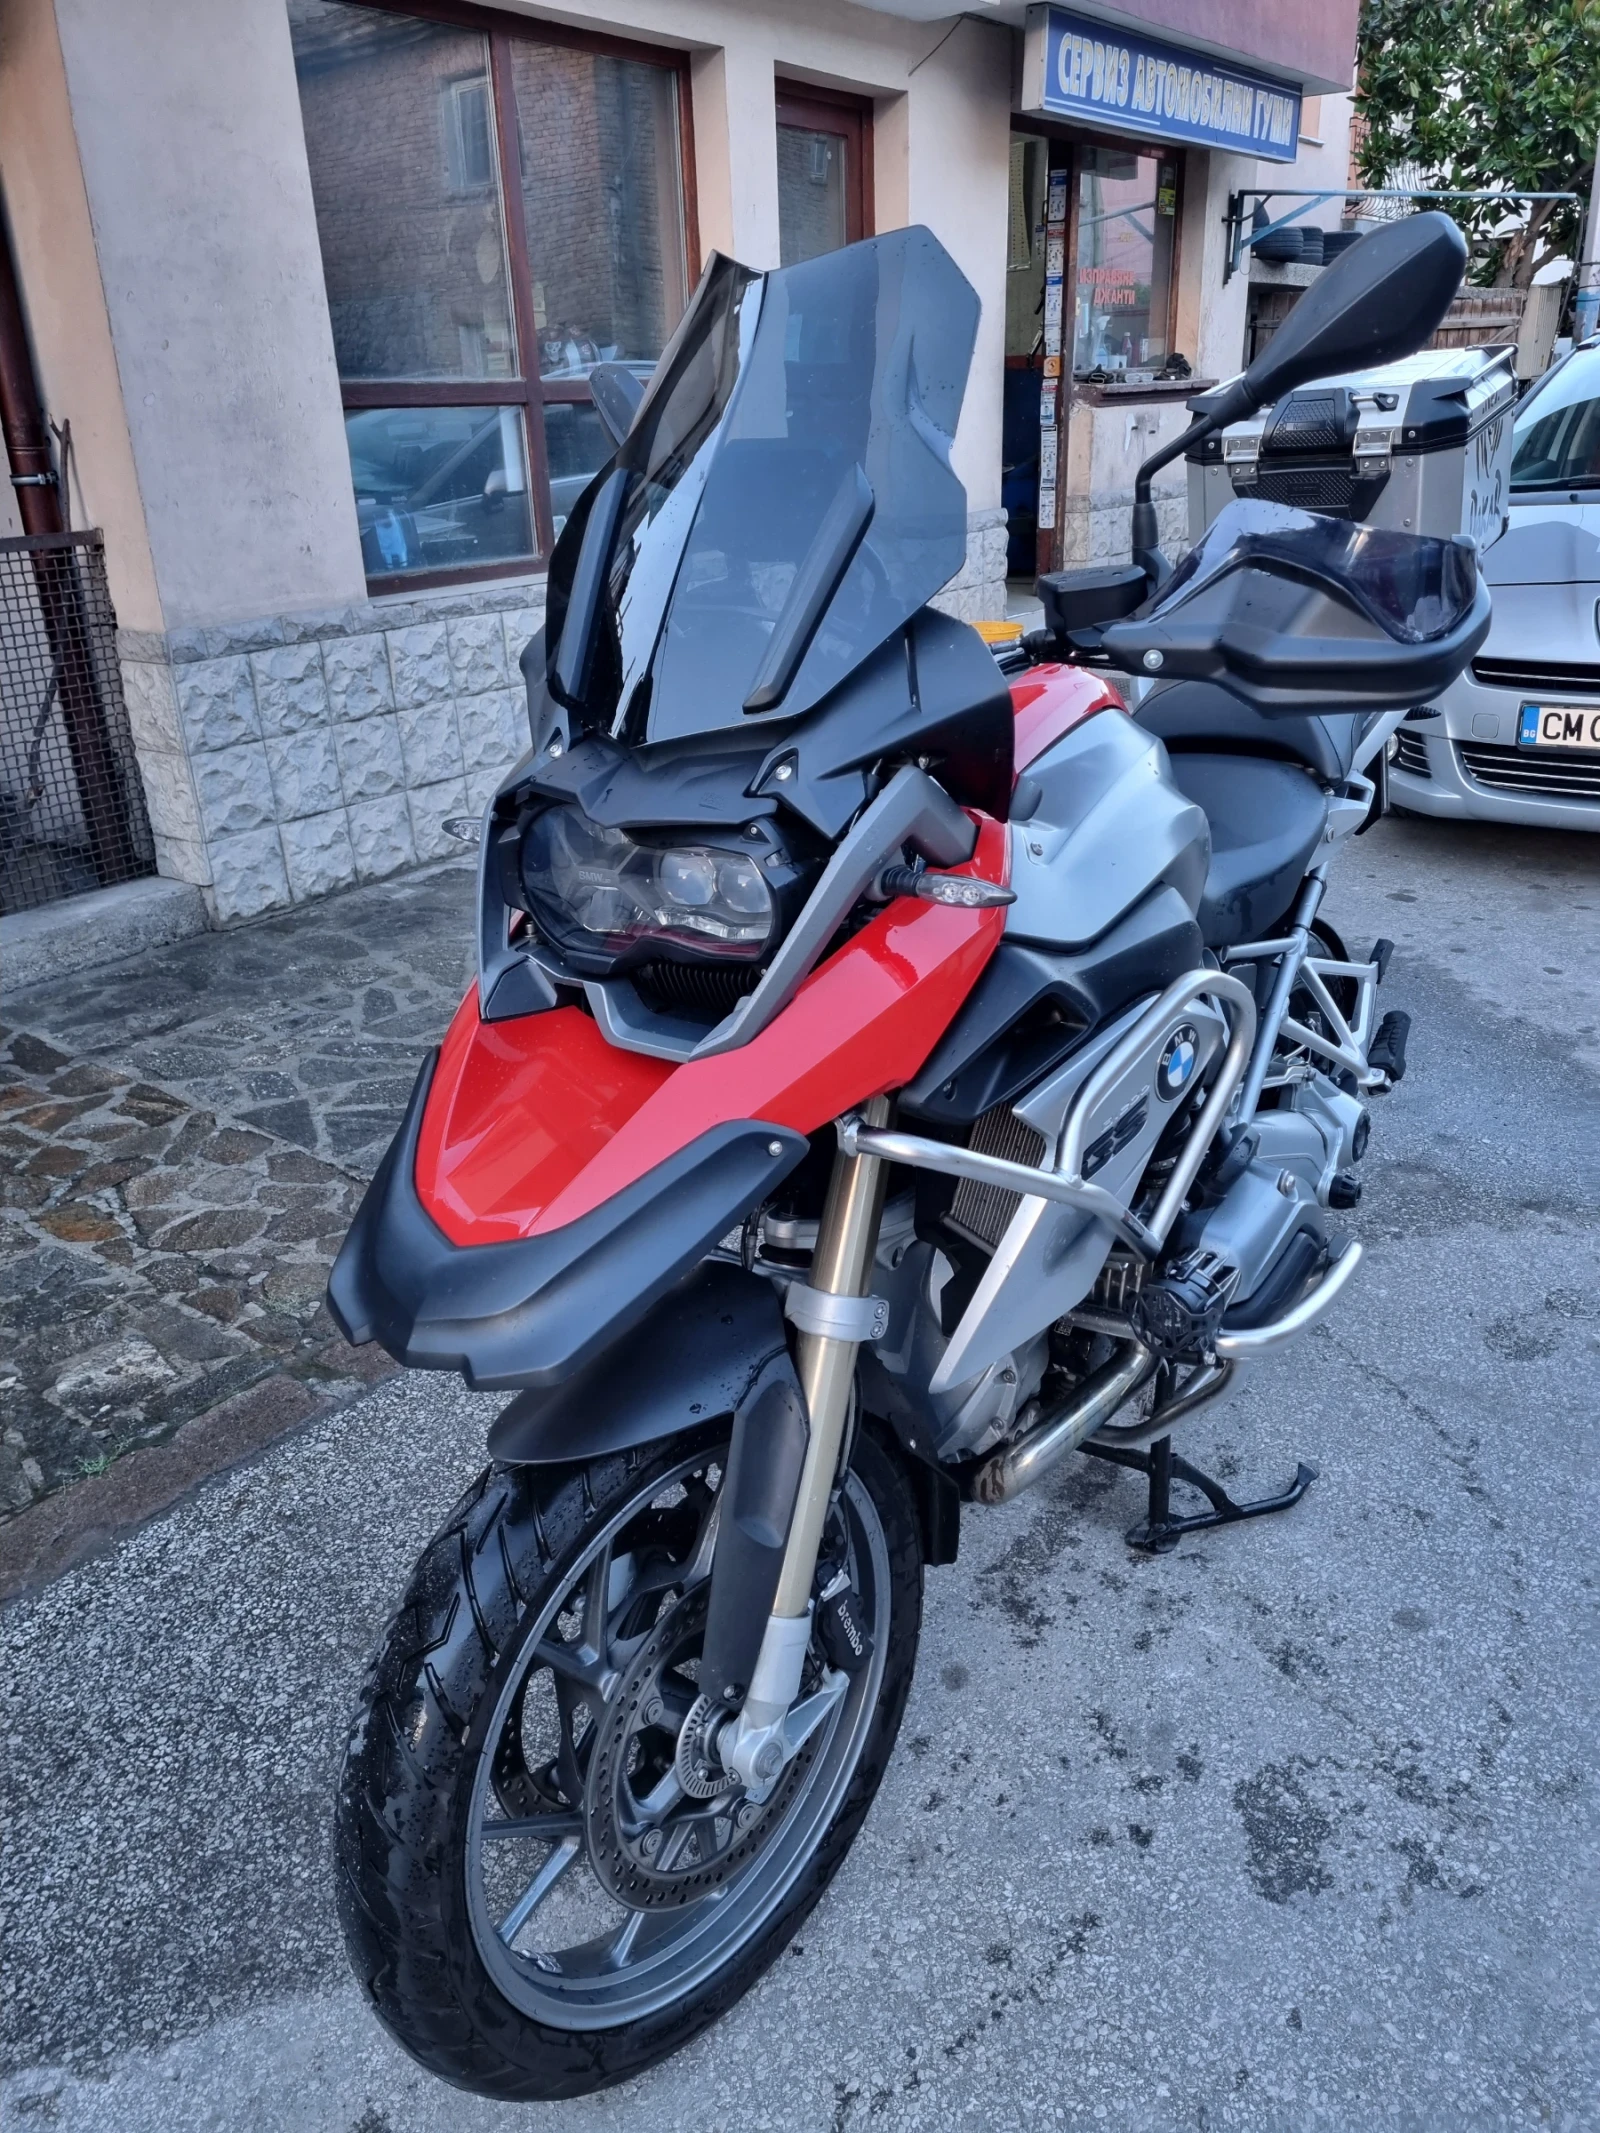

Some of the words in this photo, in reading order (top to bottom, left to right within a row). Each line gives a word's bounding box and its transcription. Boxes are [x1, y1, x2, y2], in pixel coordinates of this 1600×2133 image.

[1058, 32, 1129, 107] СЕРВИЗ
[1131, 54, 1253, 136] АВТОМОБИЛНИ
[1253, 90, 1294, 146] ГУМИ
[1093, 287, 1135, 306] ДЖАНТИ
[1523, 729, 1536, 738] BG
[579, 871, 603, 882] BMW
[1162, 1029, 1197, 1066] BMW
[837, 1599, 863, 1656] brembo
